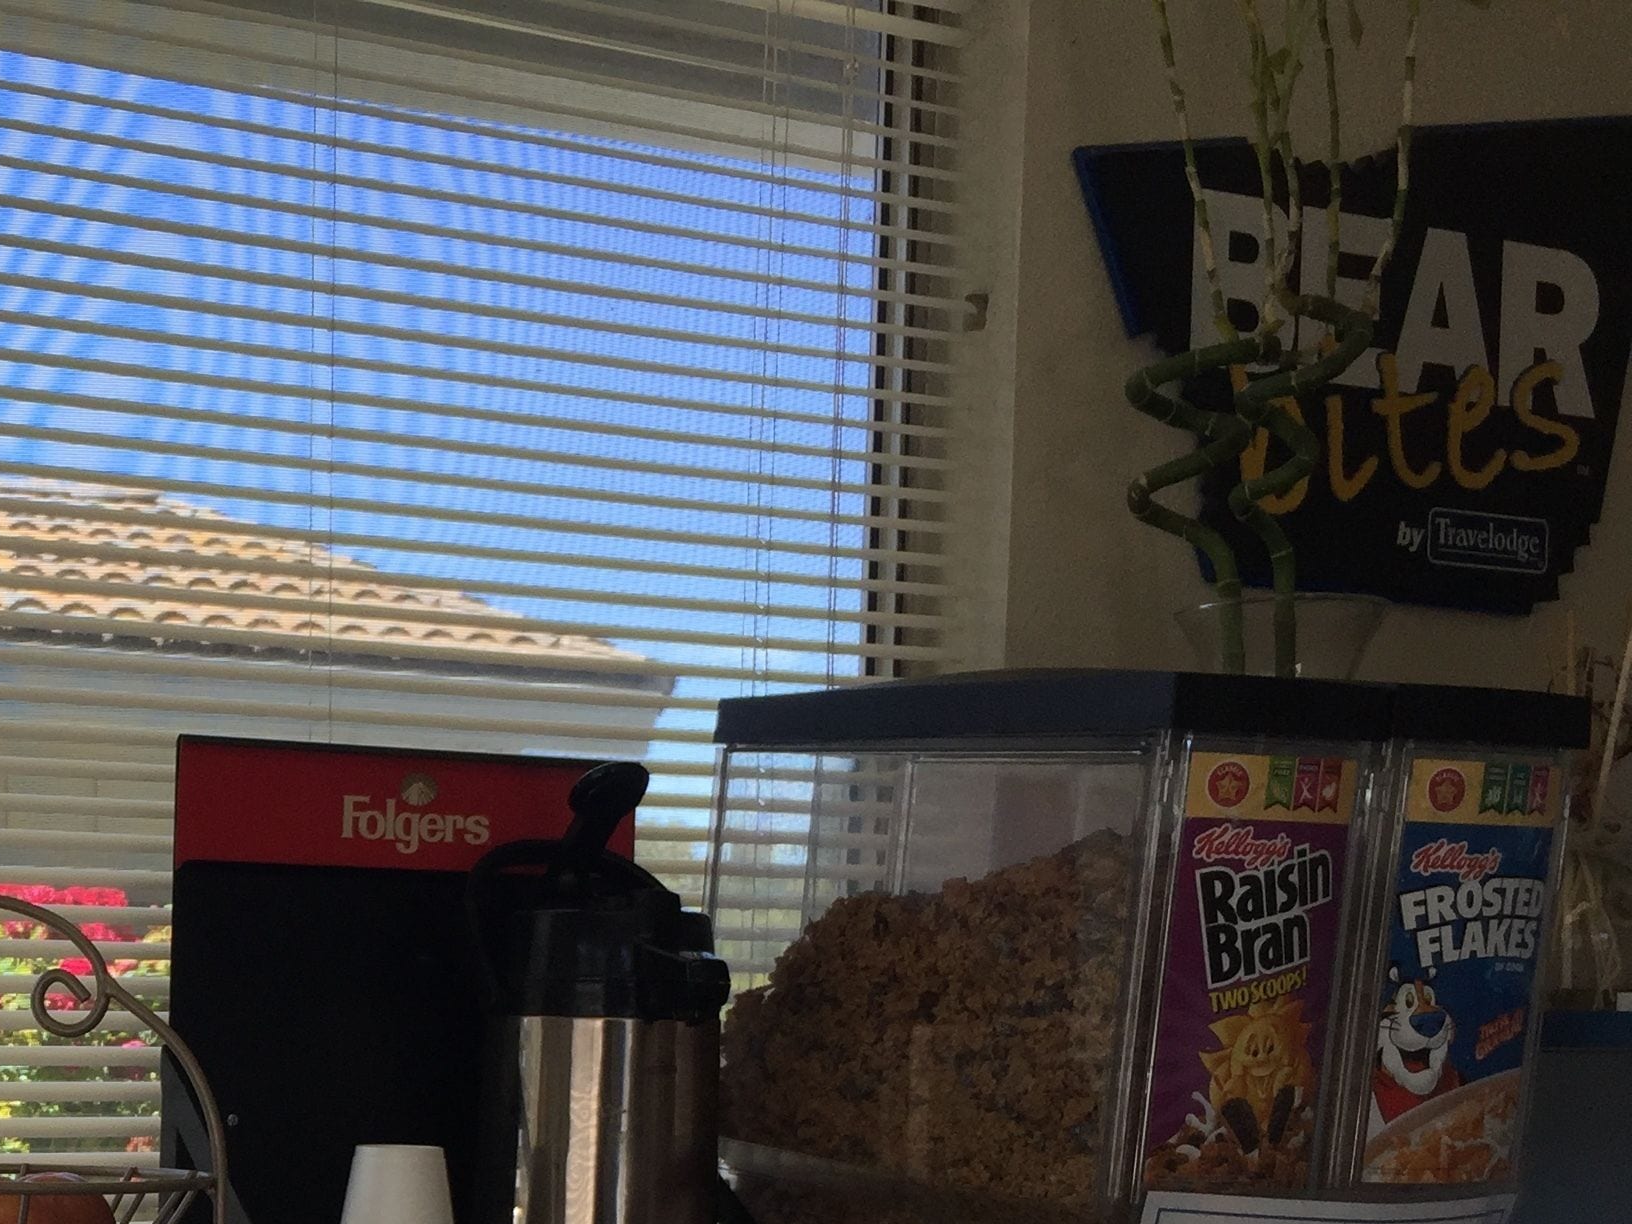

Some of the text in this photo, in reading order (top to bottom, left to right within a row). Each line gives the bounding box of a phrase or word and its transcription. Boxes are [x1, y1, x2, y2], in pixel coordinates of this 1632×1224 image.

[1190, 184, 1599, 419] BEAR
[1397, 516, 1542, 557] by Travelodge
[341, 794, 490, 854] Folgers
[1194, 824, 1292, 867] Kellogg's
[1197, 844, 1331, 927] Raisin
[1410, 839, 1501, 881] Kellogg's
[1400, 877, 1545, 931] FROSTED
[1207, 914, 1310, 988] Bran
[1417, 917, 1538, 970] FLAKES
[1209, 968, 1309, 1014] TWO SCOOPS!
